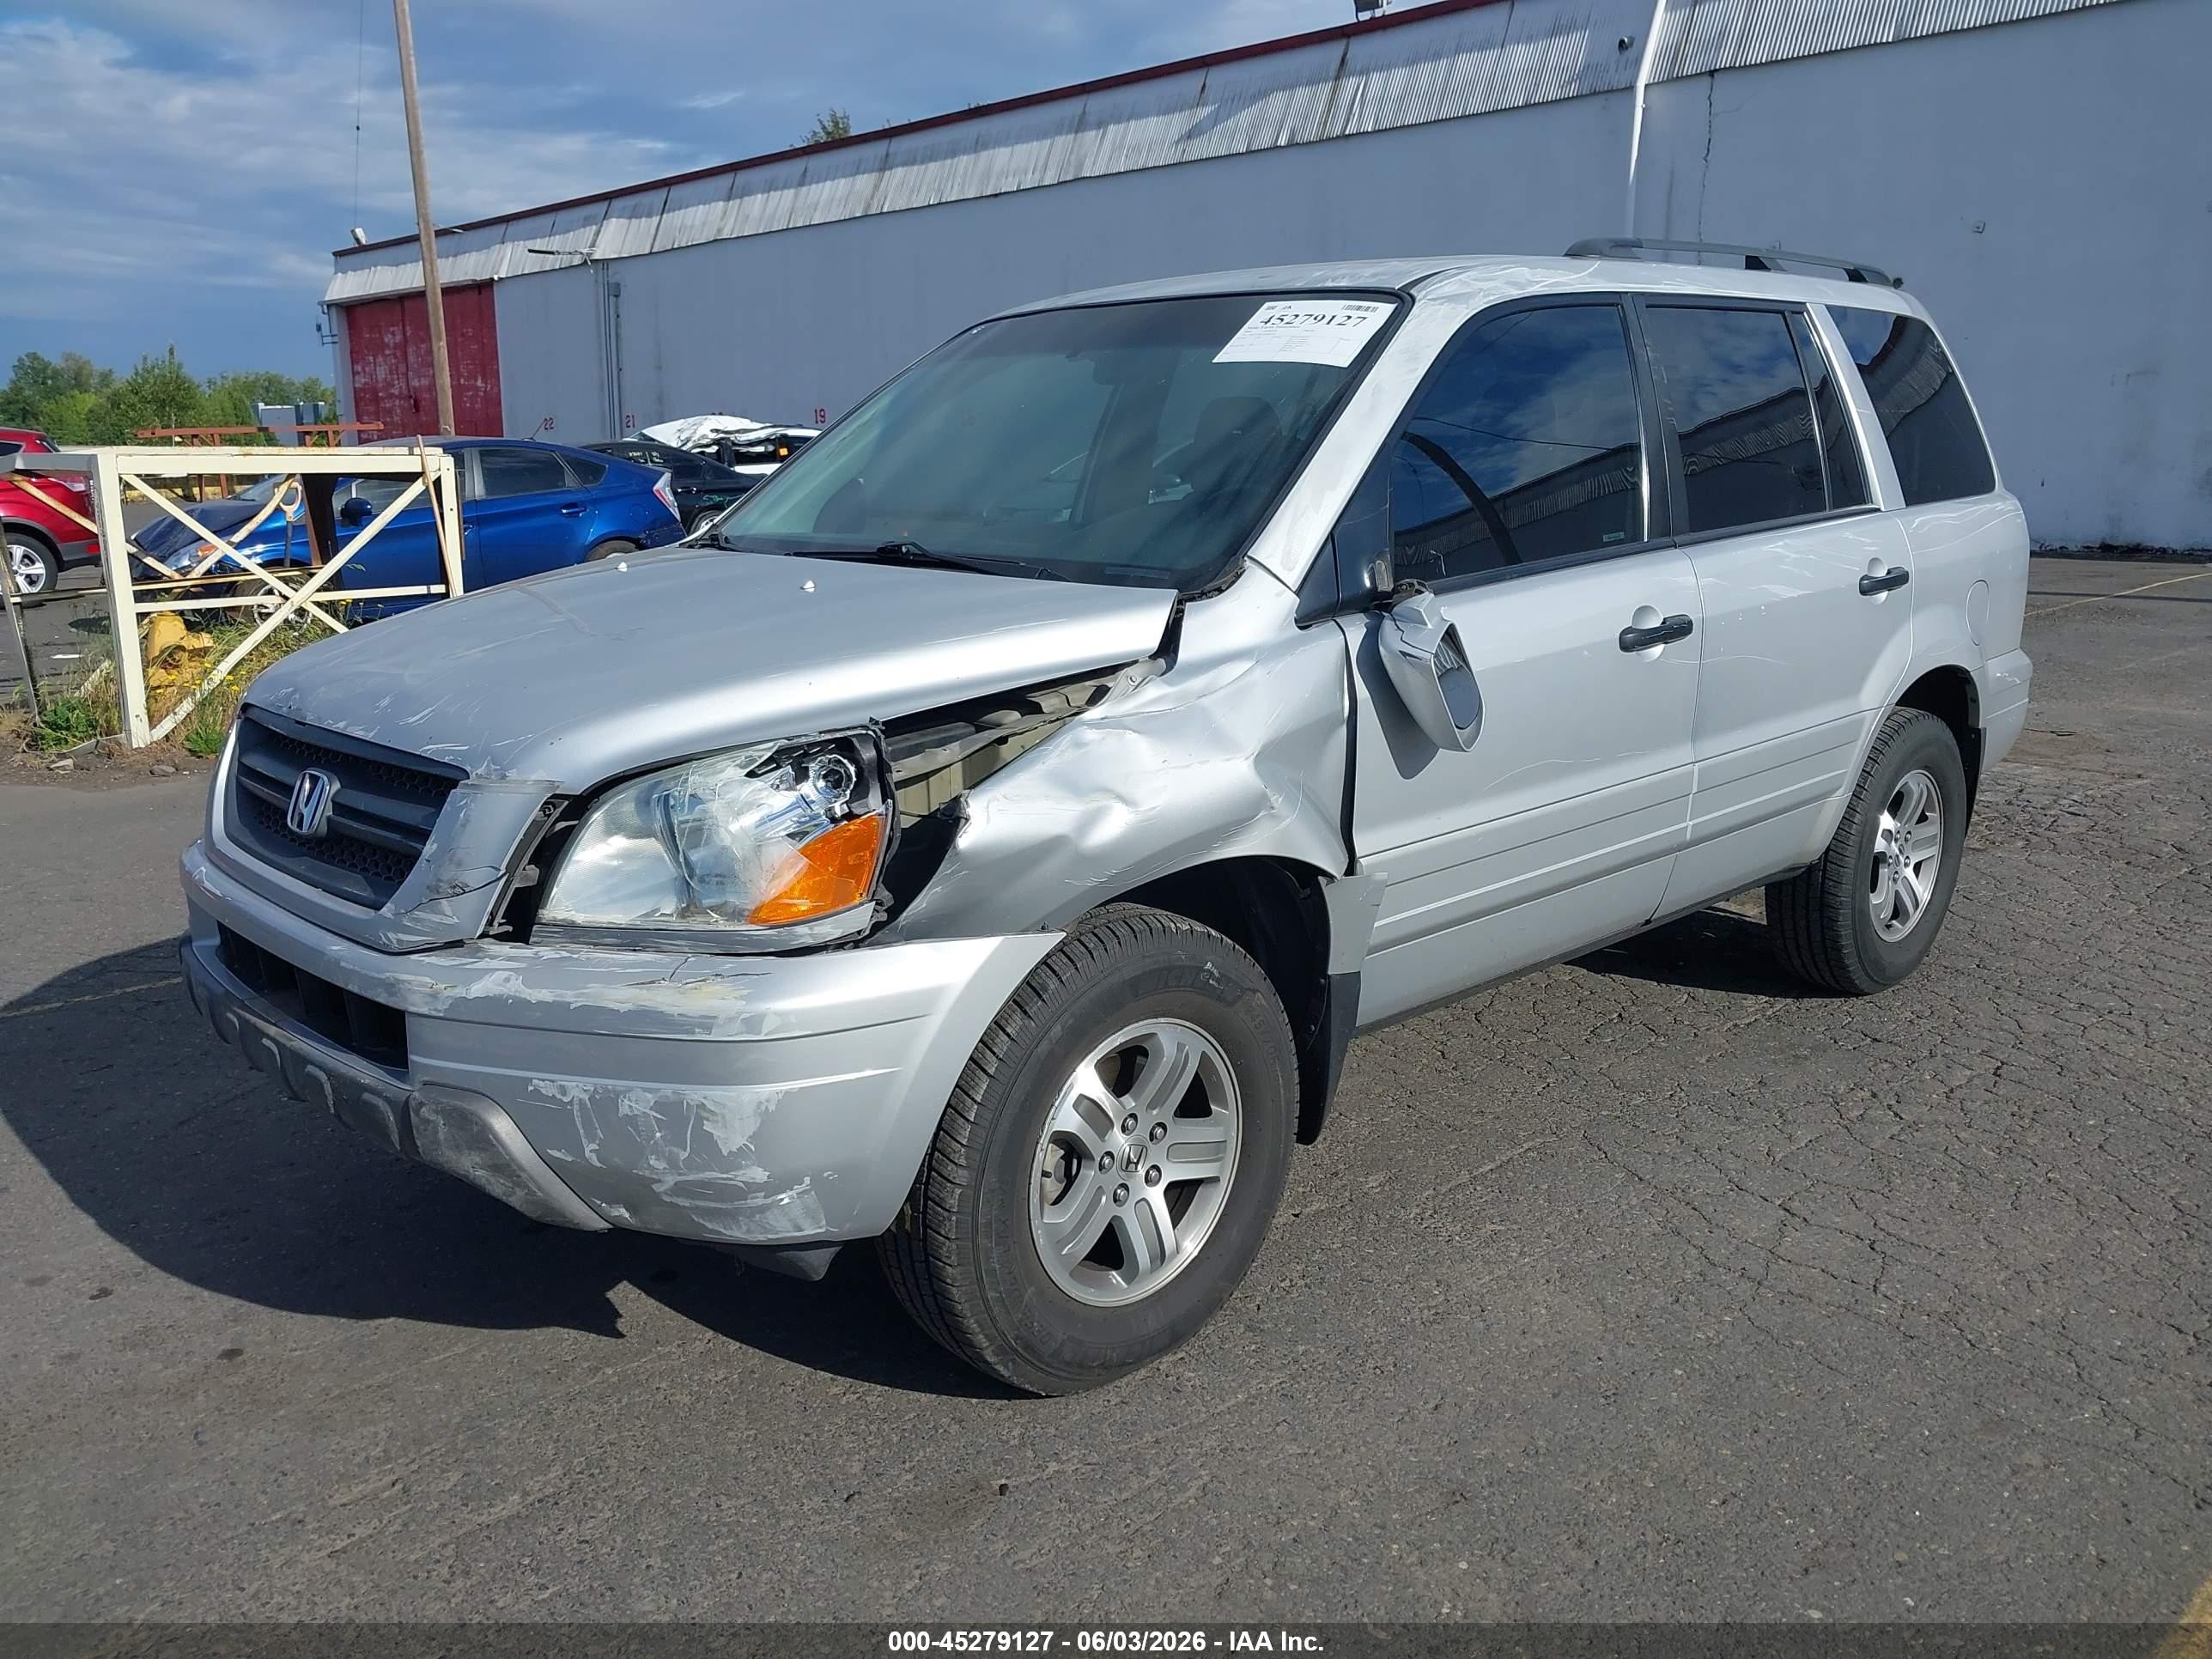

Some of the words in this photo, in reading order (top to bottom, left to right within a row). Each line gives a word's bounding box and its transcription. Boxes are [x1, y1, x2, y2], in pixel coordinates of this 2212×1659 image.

[1260, 313, 1368, 328] 45279127
[544, 416, 554, 430] 22
[625, 414, 635, 428] 21
[814, 408, 826, 424] 19
